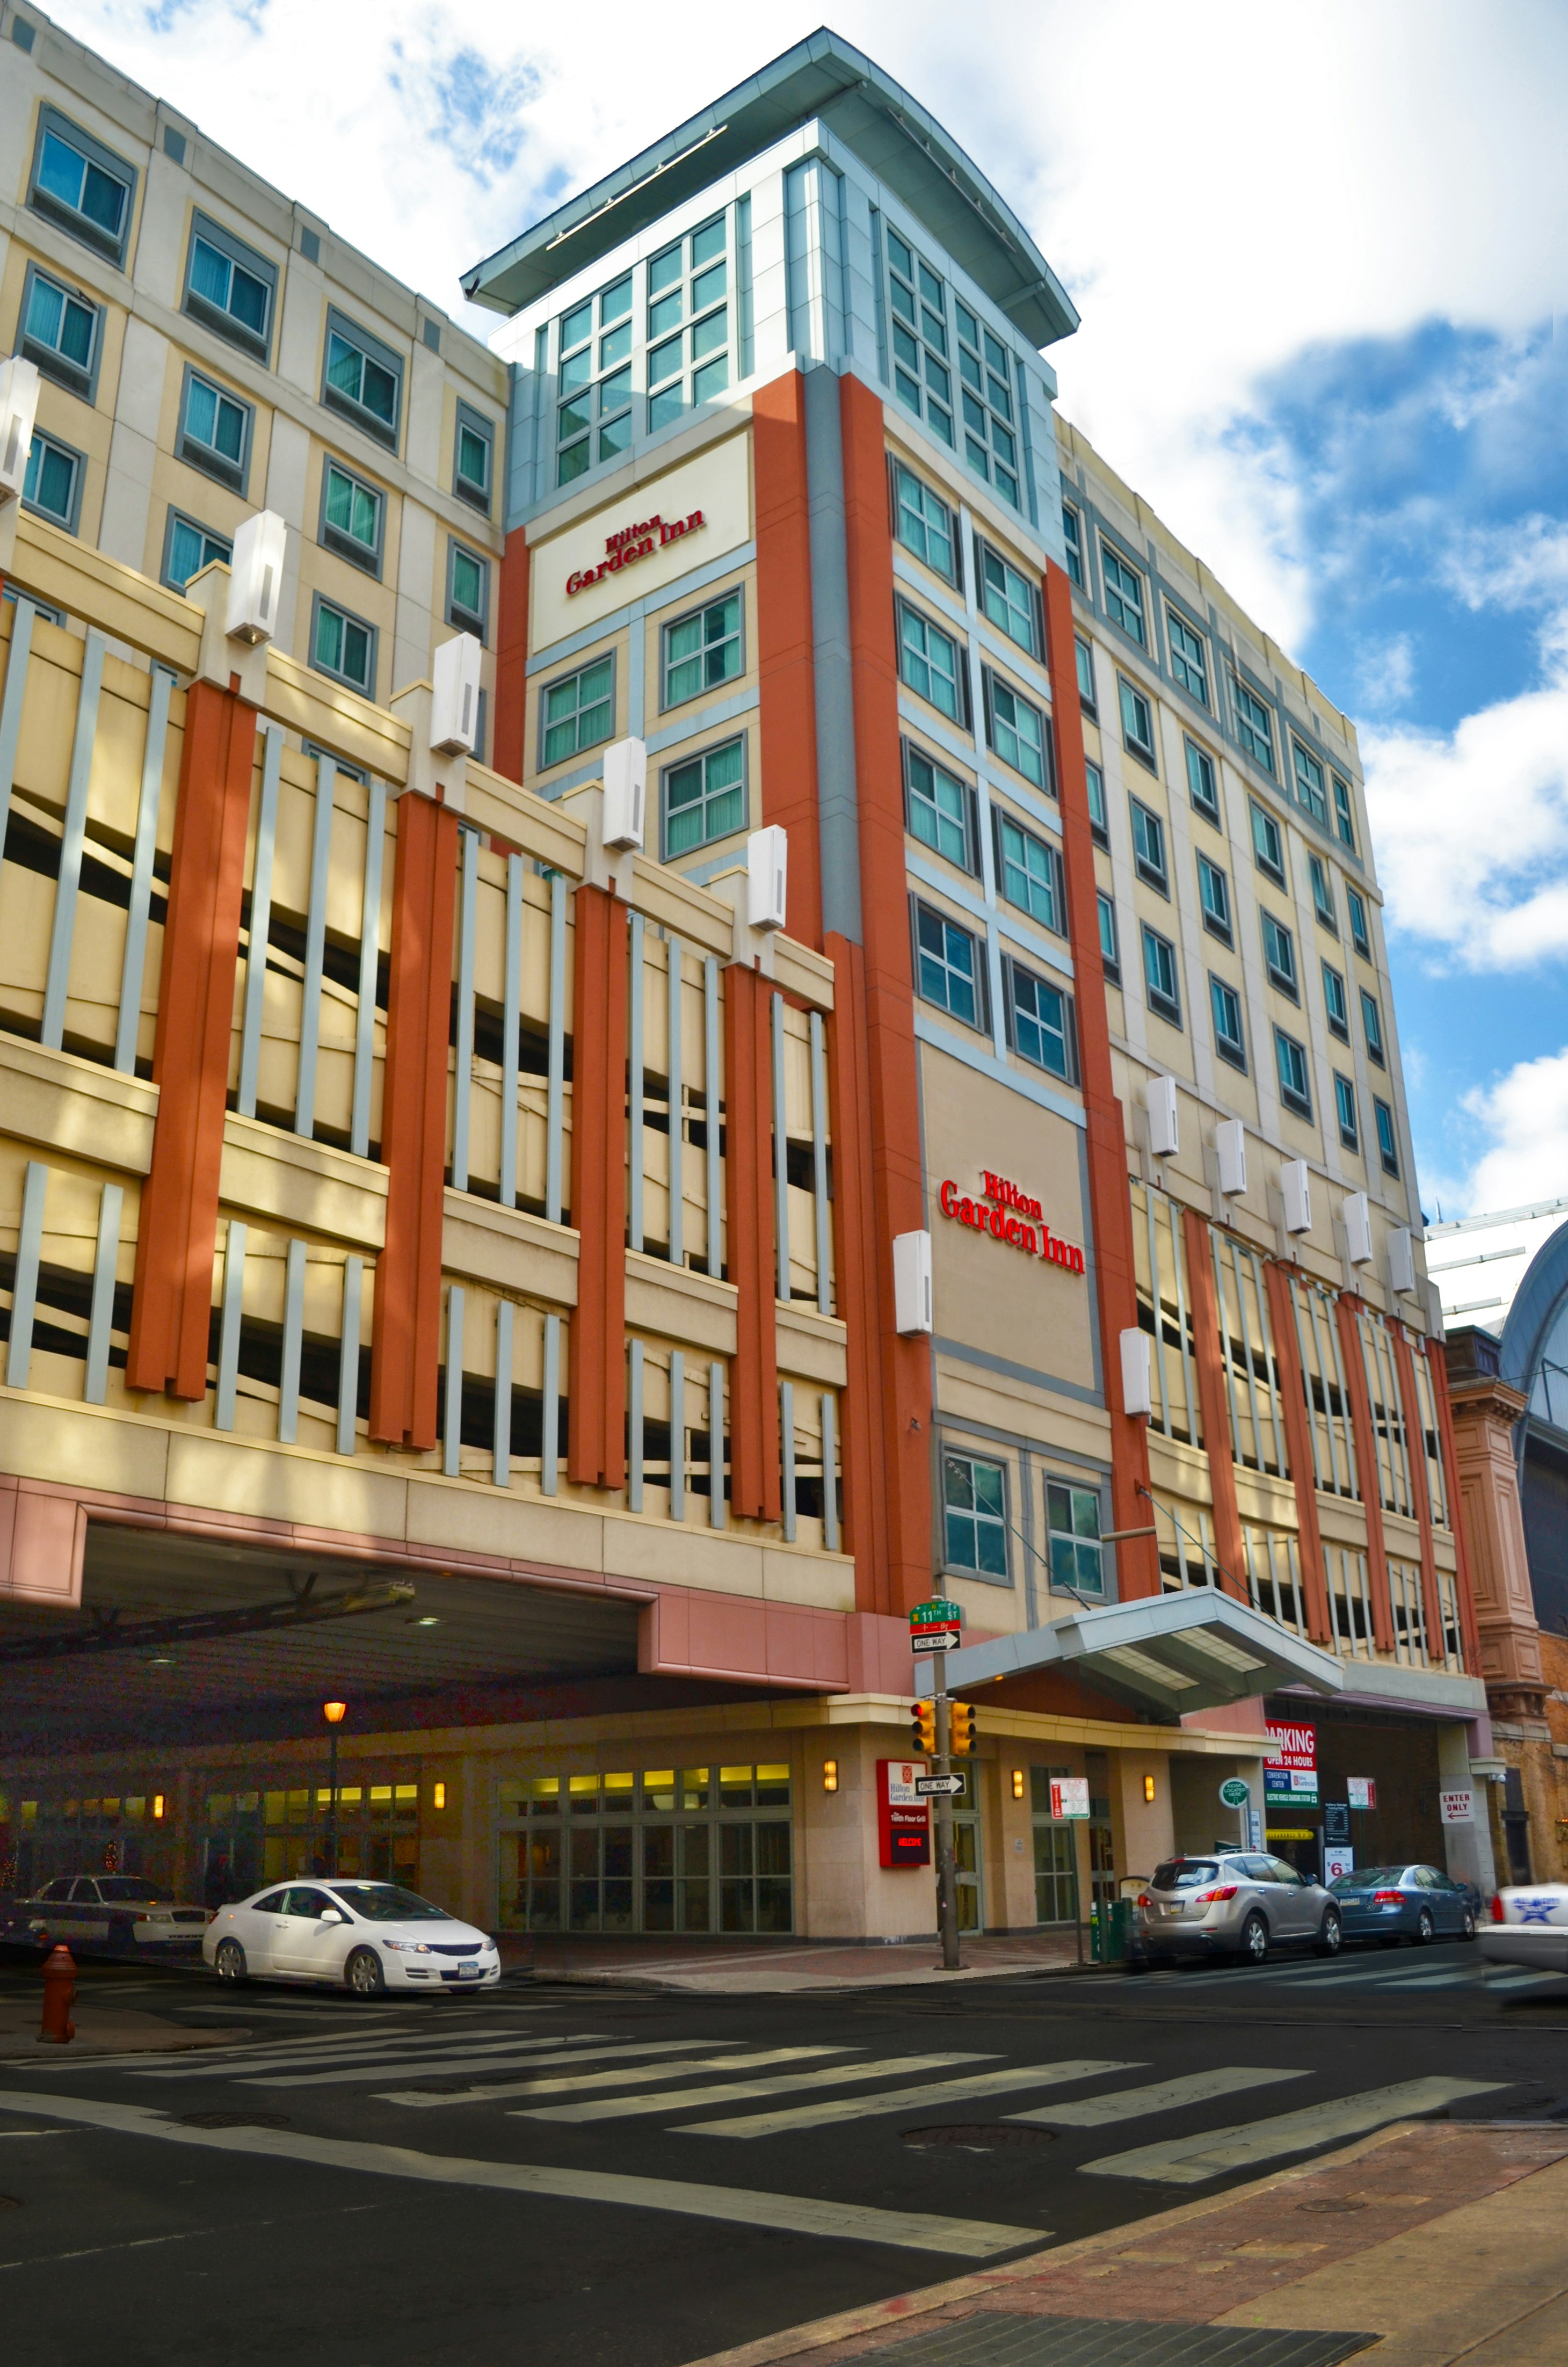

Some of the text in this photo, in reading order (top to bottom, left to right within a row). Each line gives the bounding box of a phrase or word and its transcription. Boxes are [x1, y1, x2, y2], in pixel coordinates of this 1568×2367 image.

[605, 514, 662, 555] Hilton
[565, 510, 705, 596] Garden Inn
[982, 1169, 1043, 1221] Hilton
[939, 1179, 1085, 1274] Garden Inn
[921, 1610, 958, 1622] 11TH ST
[917, 1637, 946, 1647] ONE WAY
[1265, 1726, 1315, 1754] RKING
[1283, 1755, 1292, 1766] 24
[1293, 1755, 1313, 1767] HOURS
[890, 1783, 910, 1792] Hilton
[920, 1781, 950, 1790] ONE WAY
[890, 1793, 913, 1802] Garden
[1443, 1794, 1470, 1802] ENTER
[1447, 1803, 1468, 1811] ONLY
[898, 1837, 922, 1847] WELCOME
[1331, 1862, 1343, 1877] 6
